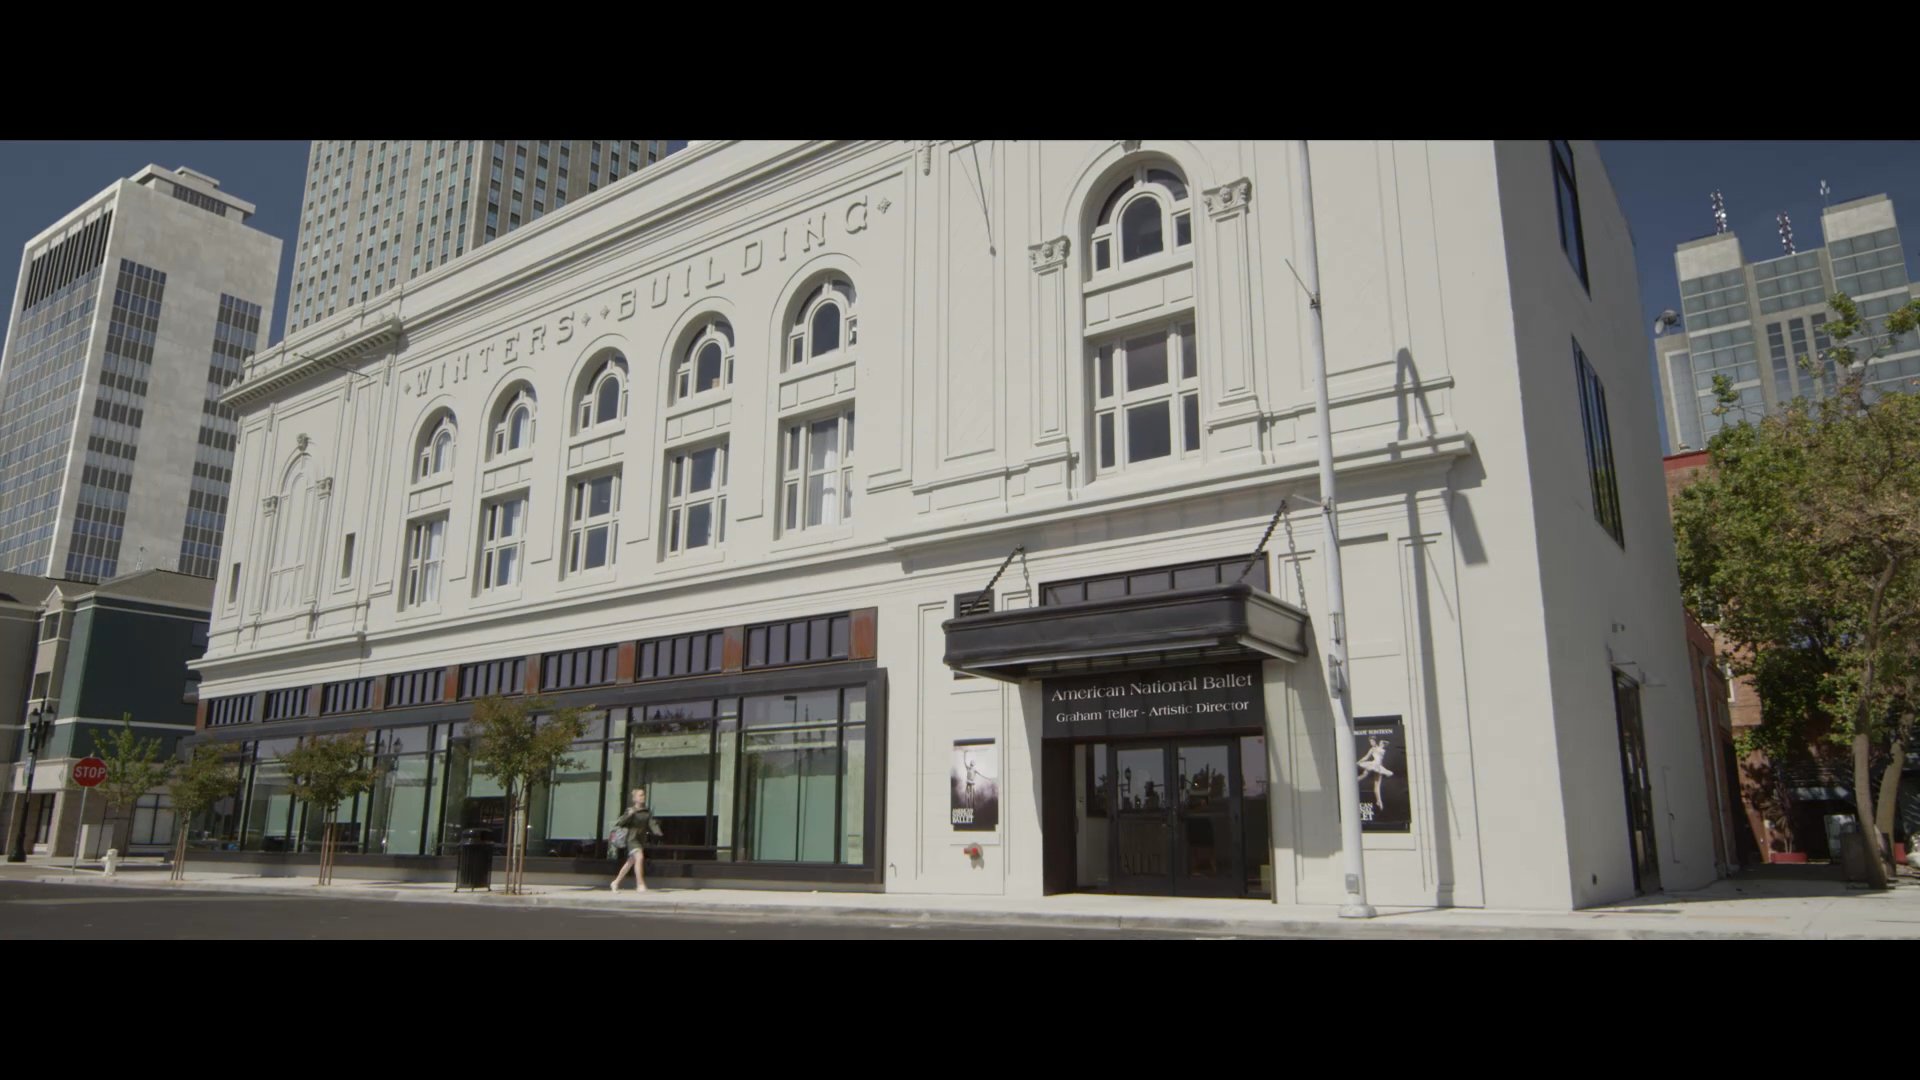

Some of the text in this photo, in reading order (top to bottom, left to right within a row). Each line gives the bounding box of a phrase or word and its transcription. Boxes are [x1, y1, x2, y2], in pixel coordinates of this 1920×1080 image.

[414, 194, 869, 398] WINTERS BUILDING
[1052, 672, 1252, 702] American National Ballet
[1056, 709, 1102, 723] Graham
[1105, 707, 1139, 720] Teller
[1149, 703, 1193, 717] Artistic
[1196, 700, 1249, 713] Director
[74, 766, 106, 779] STOP
